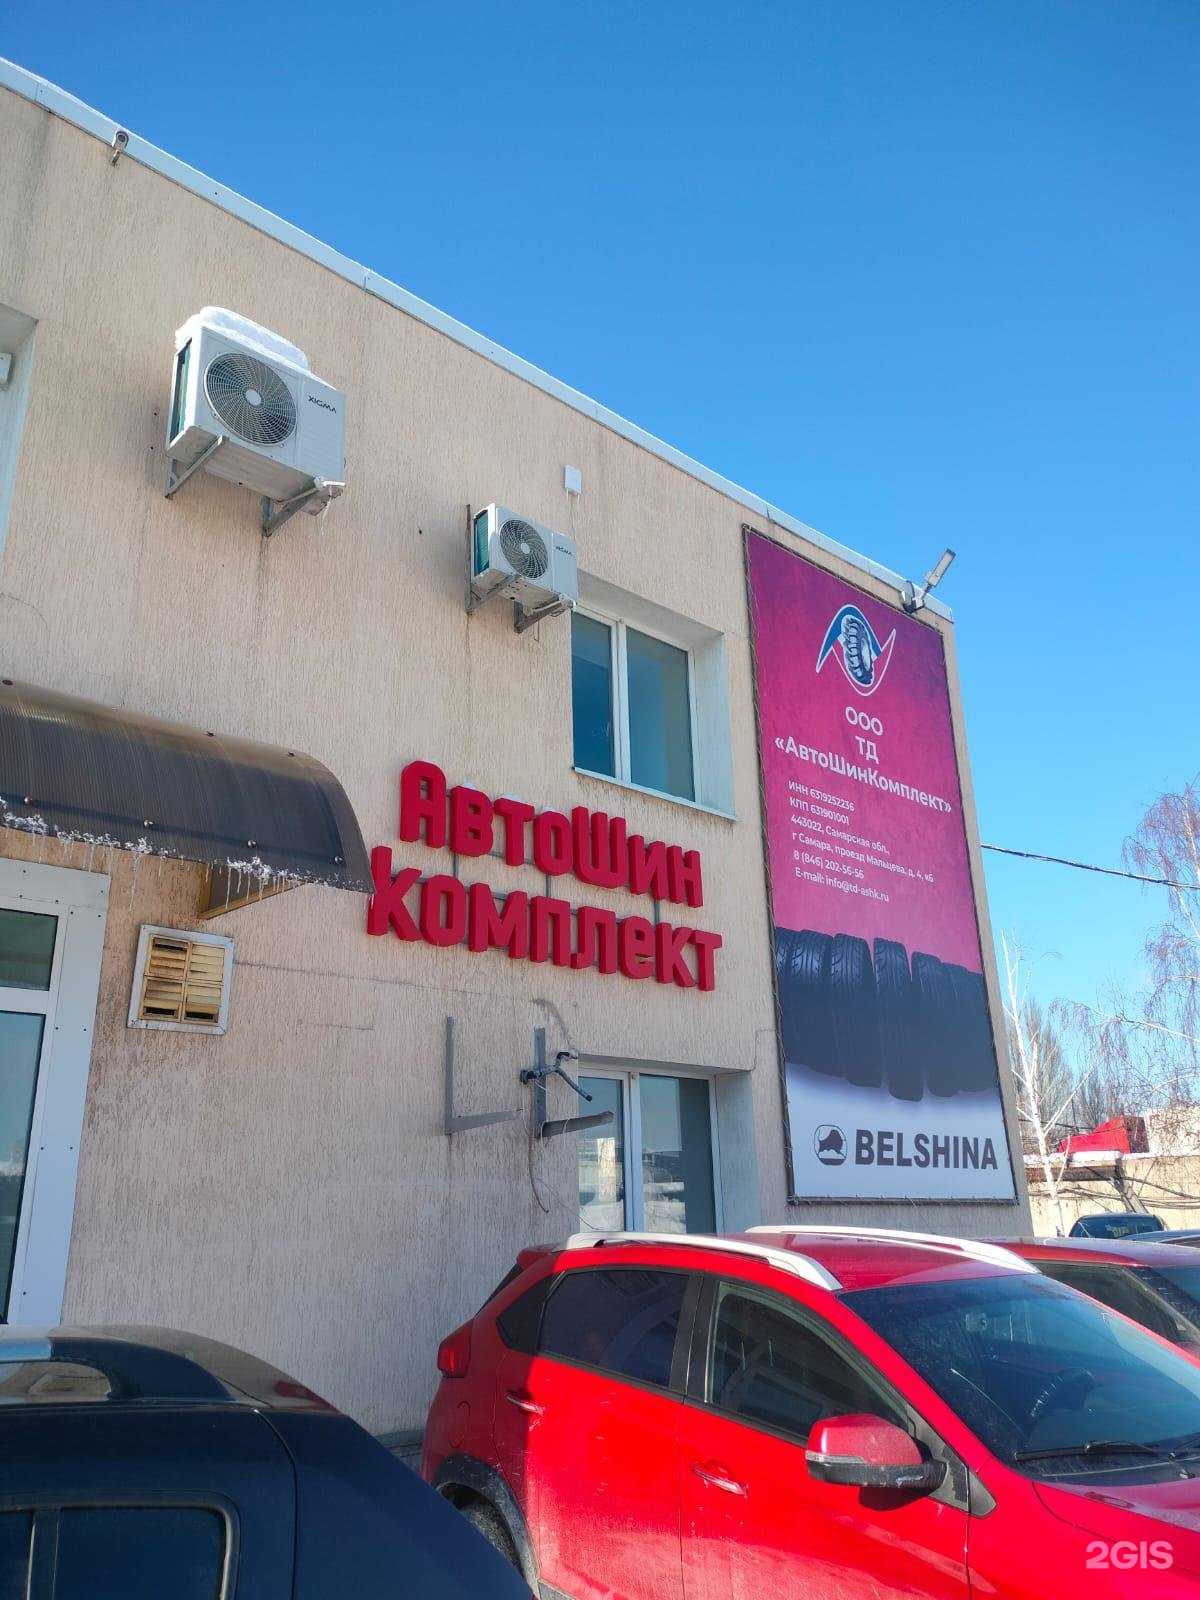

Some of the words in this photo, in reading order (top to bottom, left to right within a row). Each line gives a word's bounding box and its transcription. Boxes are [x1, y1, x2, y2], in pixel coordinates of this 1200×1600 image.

[308, 395, 337, 414] XIGMA
[845, 706, 884, 736] ООО
[855, 735, 880, 764] ТД
[774, 736, 952, 813] «АвтоШинКомплект»
[788, 780, 809, 796] ИНН
[809, 788, 855, 812] 6319252236
[789, 796, 809, 812] КПП
[810, 804, 850, 825] 631901001
[400, 760, 704, 909] АвтоШин
[791, 814, 825, 835] 443022,
[825, 825, 872, 848] Самарская
[793, 849, 800, 860] 8
[801, 851, 824, 869] (846)
[798, 833, 834, 854] Самара,
[835, 846, 866, 863] проезд
[795, 866, 825, 884] E-mail:
[366, 845, 723, 992] Комплект
[855, 1128, 999, 1170] BELSHINA
